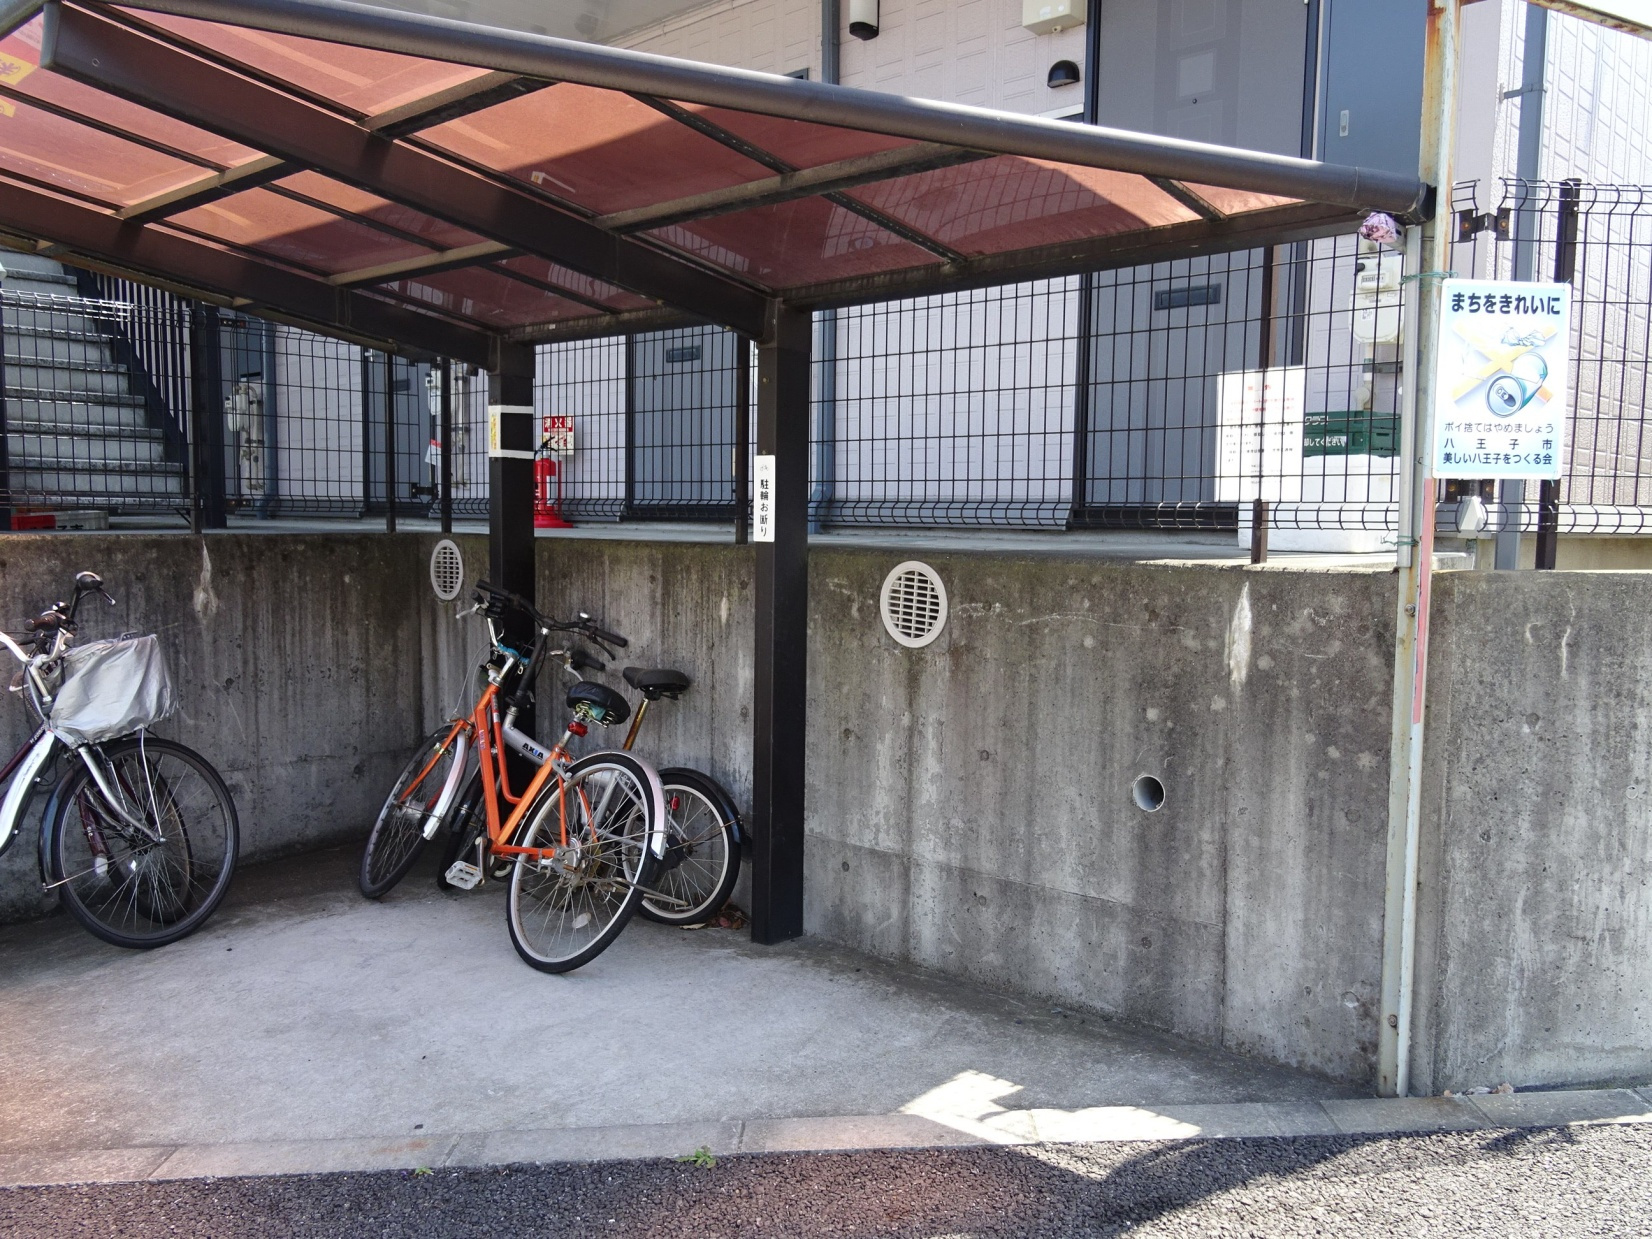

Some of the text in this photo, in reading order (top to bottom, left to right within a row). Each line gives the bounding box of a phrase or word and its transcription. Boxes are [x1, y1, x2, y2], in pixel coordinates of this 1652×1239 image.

[1451, 292, 1561, 316] まちをきれいに
[1444, 422, 1554, 434] ポイ捨てはやめましょう
[1442, 452, 1553, 465] 美しい八王子をつくる会
[759, 478, 769, 537] 駐輪お断り
[522, 742, 544, 760] AXIA
